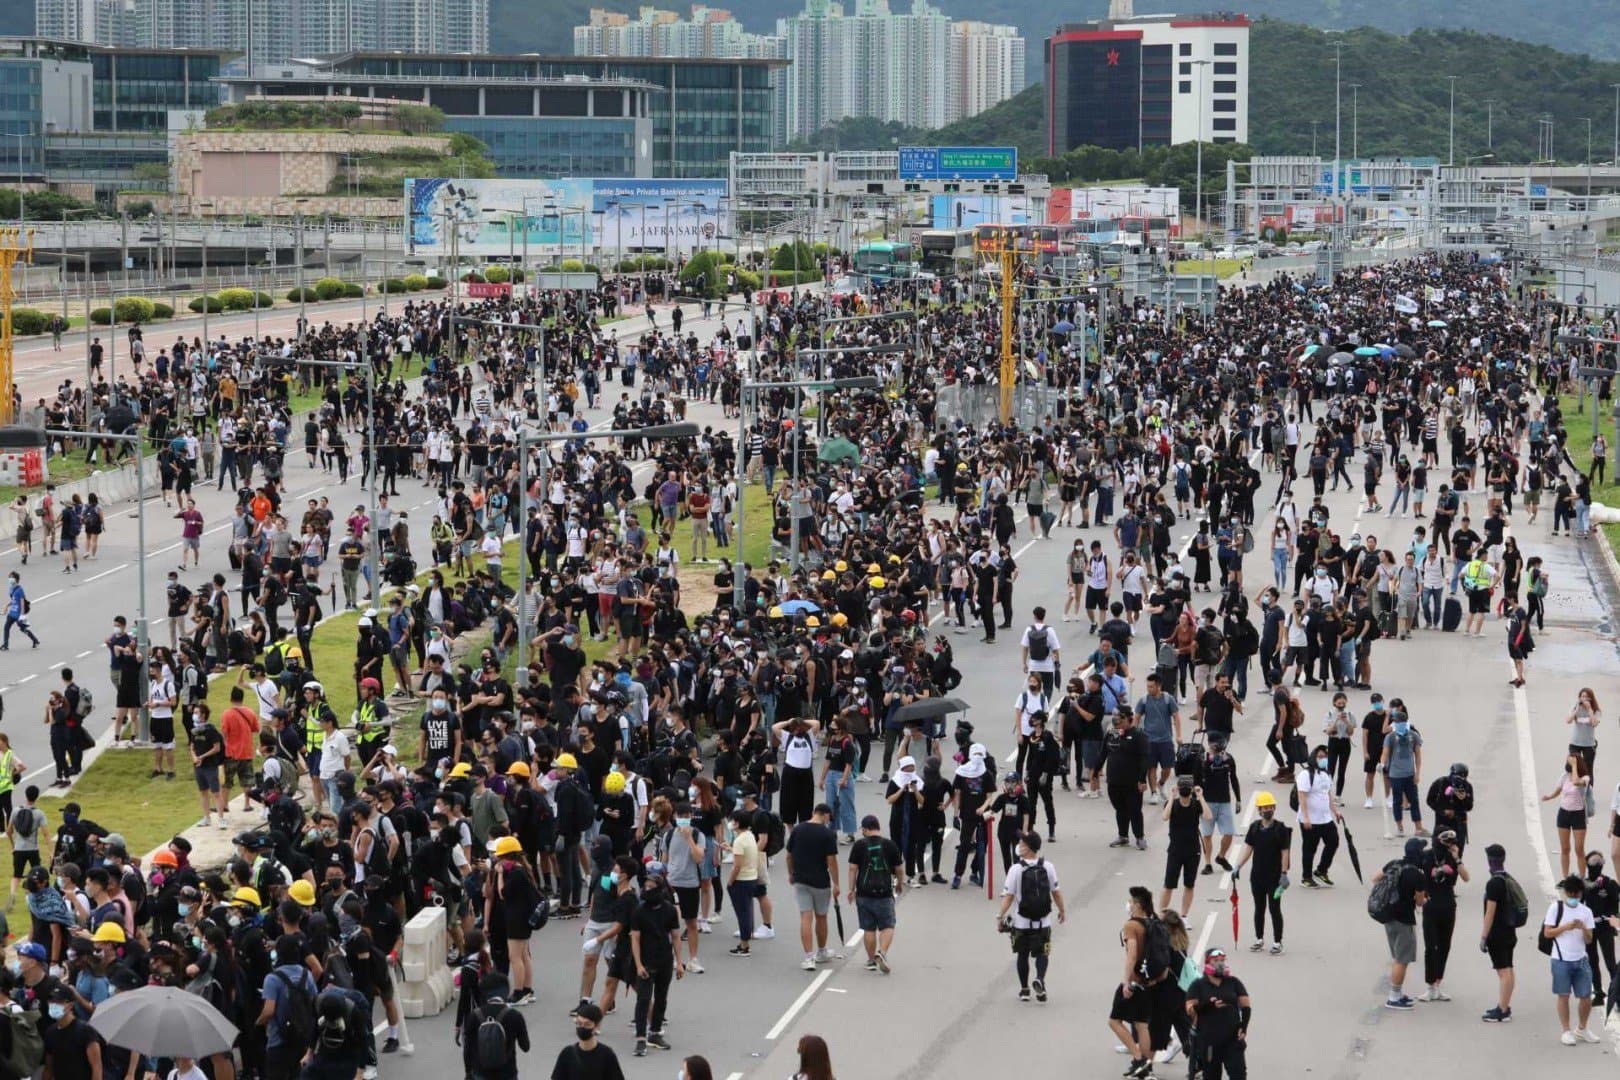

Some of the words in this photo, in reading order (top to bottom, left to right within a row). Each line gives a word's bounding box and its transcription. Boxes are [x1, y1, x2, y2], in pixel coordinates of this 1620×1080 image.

[631, 227, 637, 238] J.
[640, 226, 674, 236] SAFRA
[427, 720, 448, 728] LIVE
[428, 728, 448, 737] THE
[430, 741, 448, 749] LIFE
